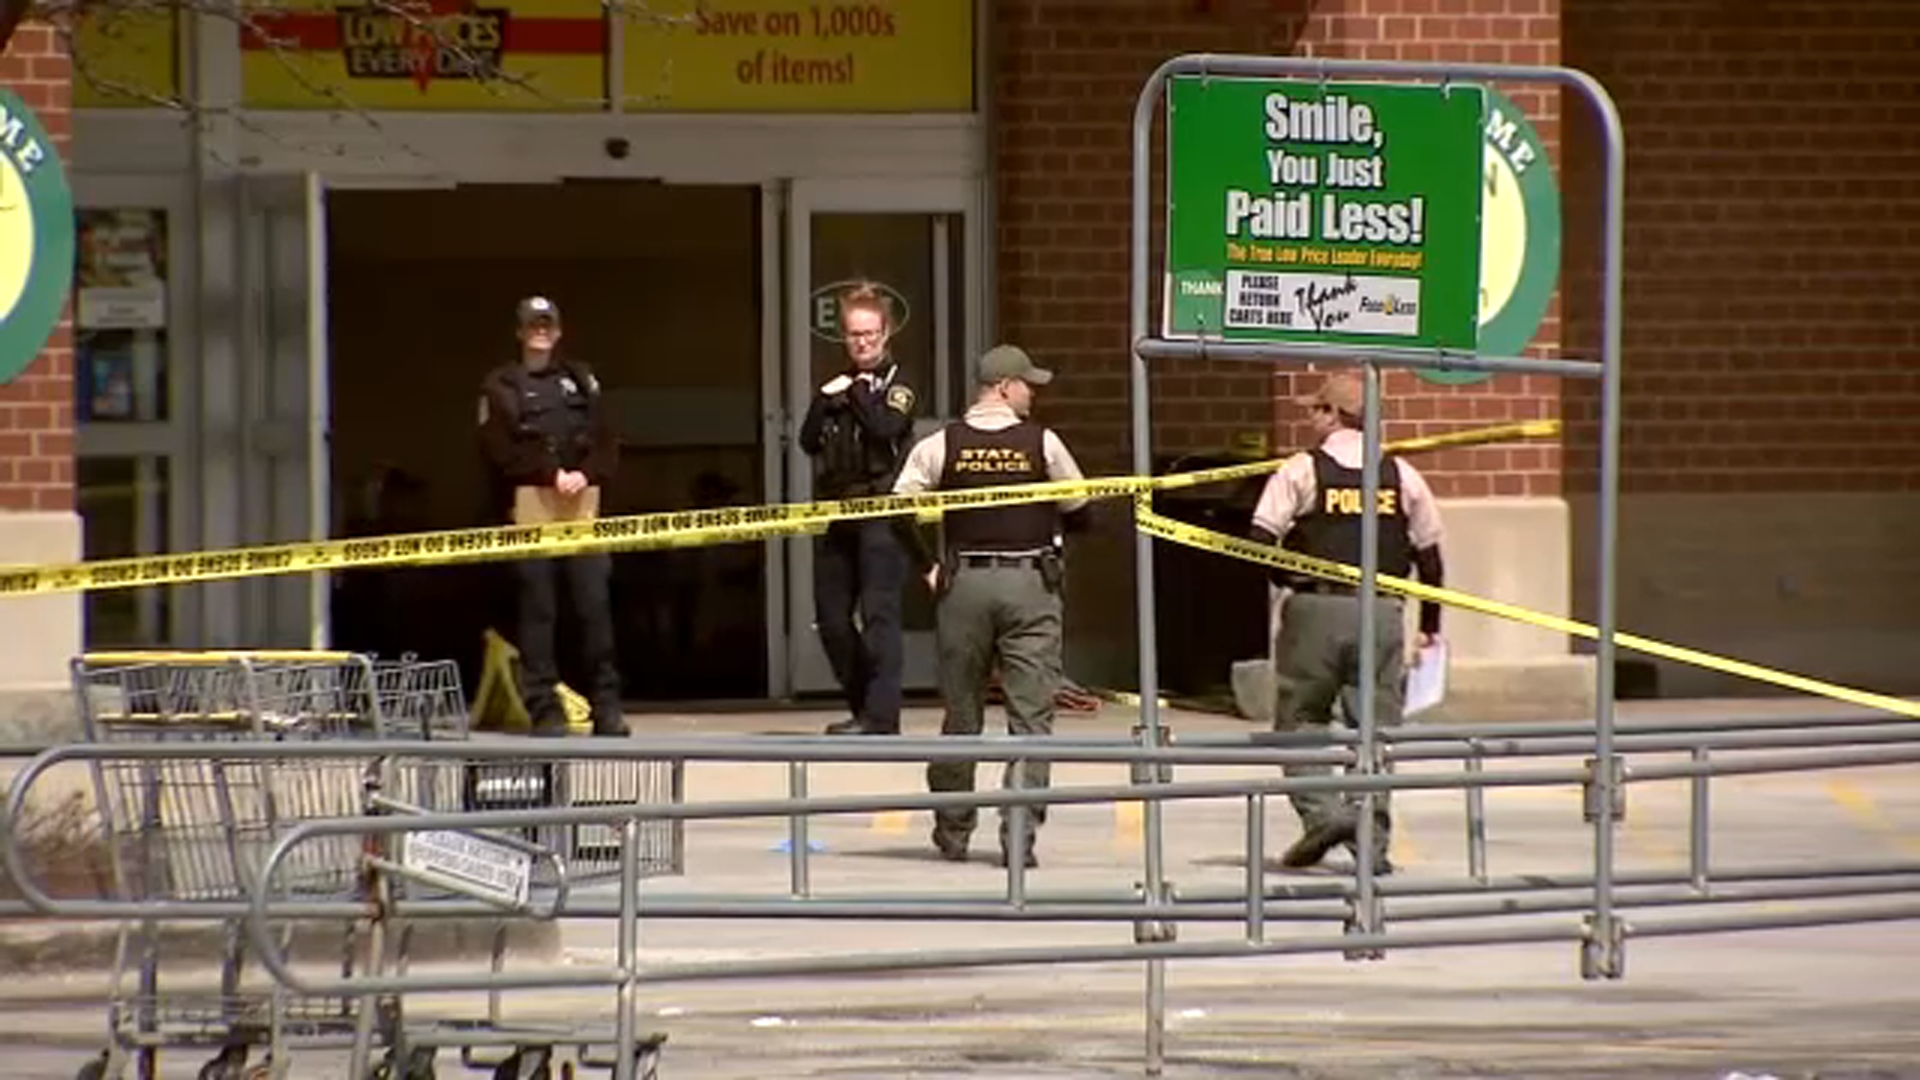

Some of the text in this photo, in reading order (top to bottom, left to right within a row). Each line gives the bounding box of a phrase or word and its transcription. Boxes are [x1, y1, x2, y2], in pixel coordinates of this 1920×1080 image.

[695, 5, 895, 40] Save on 1,000s
[737, 48, 853, 84] of items!
[1264, 94, 1384, 147] Smile,
[1267, 149, 1384, 188] You Just
[1226, 190, 1424, 243] Paid Less!
[1227, 243, 1247, 260] The
[1250, 245, 1273, 261] True
[1276, 247, 1297, 262] Low
[1301, 248, 1328, 264] Price
[1331, 249, 1368, 265] Leader
[1241, 275, 1280, 291] PLEASE
[1294, 271, 1358, 317] Thank
[1239, 291, 1281, 307] RETURN
[1229, 308, 1294, 325] CARTS HERE
[1308, 304, 1349, 334] You
[956, 461, 1031, 472] POLICE
[1326, 488, 1397, 514] POLCE
